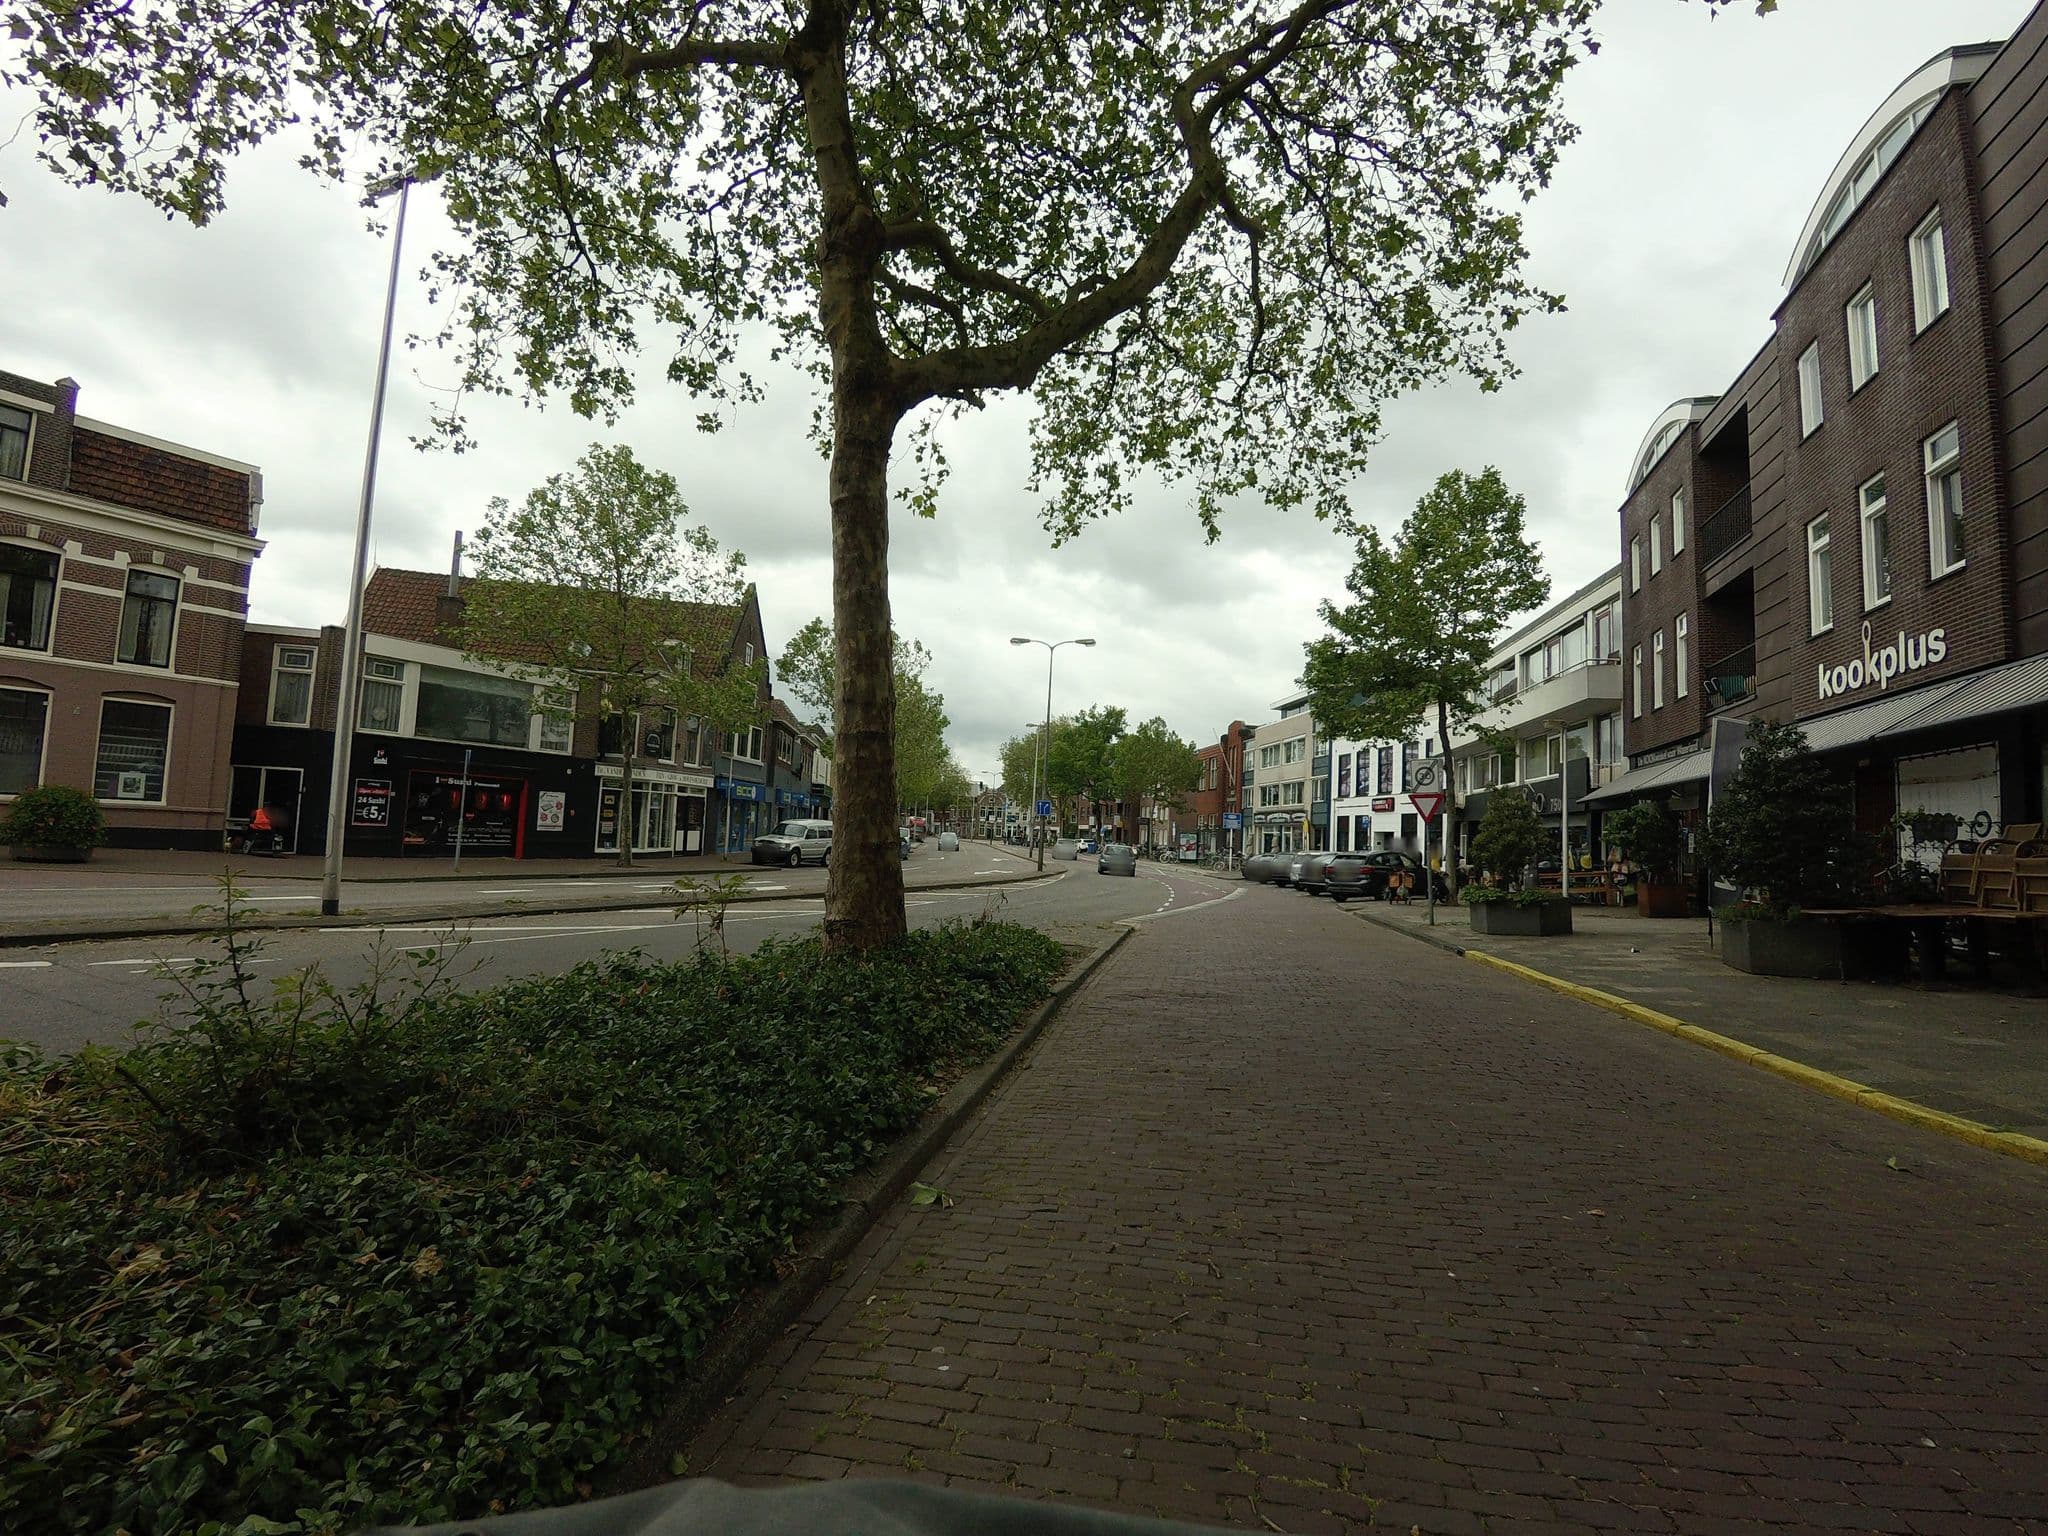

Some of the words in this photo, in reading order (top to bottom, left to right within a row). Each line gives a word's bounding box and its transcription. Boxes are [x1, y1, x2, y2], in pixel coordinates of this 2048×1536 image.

[1818, 621, 1947, 700] kookplus
[357, 796, 367, 804] 24
[368, 796, 385, 805] Sushi
